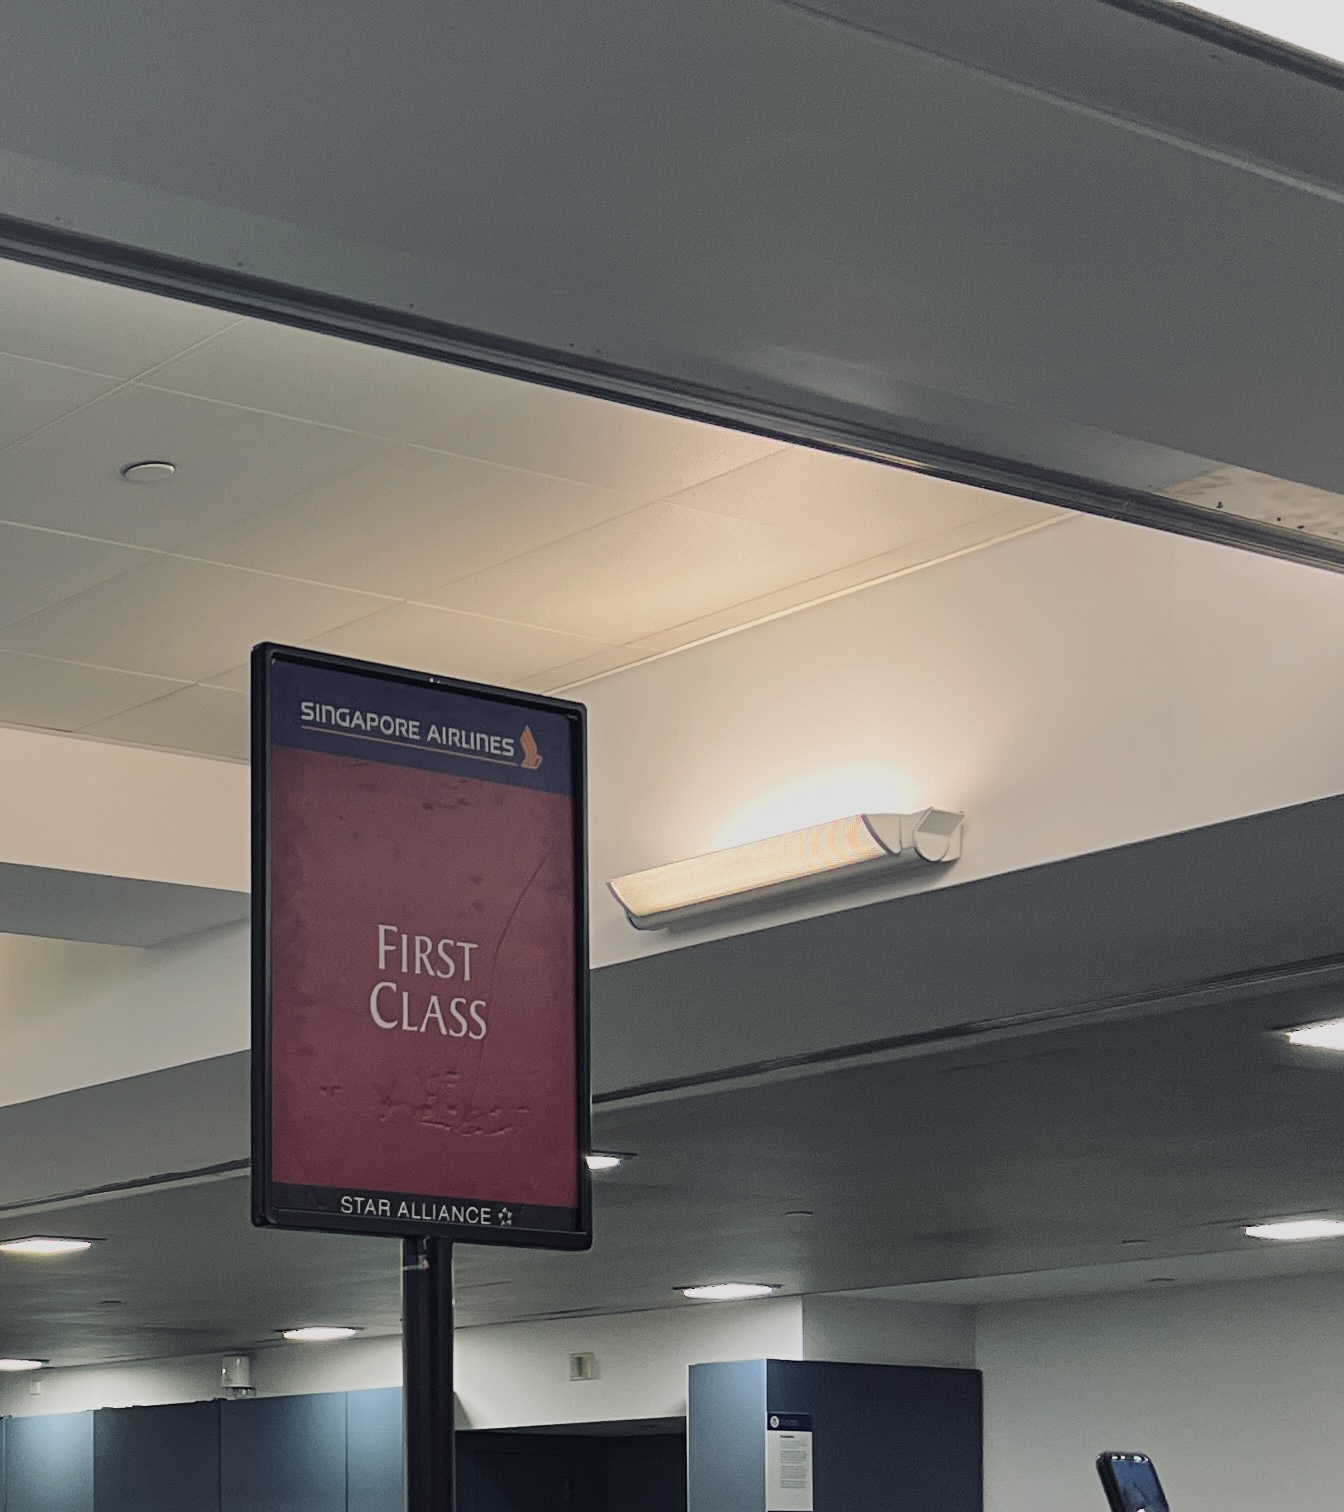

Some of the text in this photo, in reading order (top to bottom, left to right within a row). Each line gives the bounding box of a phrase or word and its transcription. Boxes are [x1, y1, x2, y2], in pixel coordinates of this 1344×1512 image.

[300, 701, 515, 758] SINGAPORE AIRLINES
[377, 924, 480, 982] FIRST
[369, 981, 488, 1041] CLASS
[340, 1195, 492, 1226] STAR ALLIANCE
